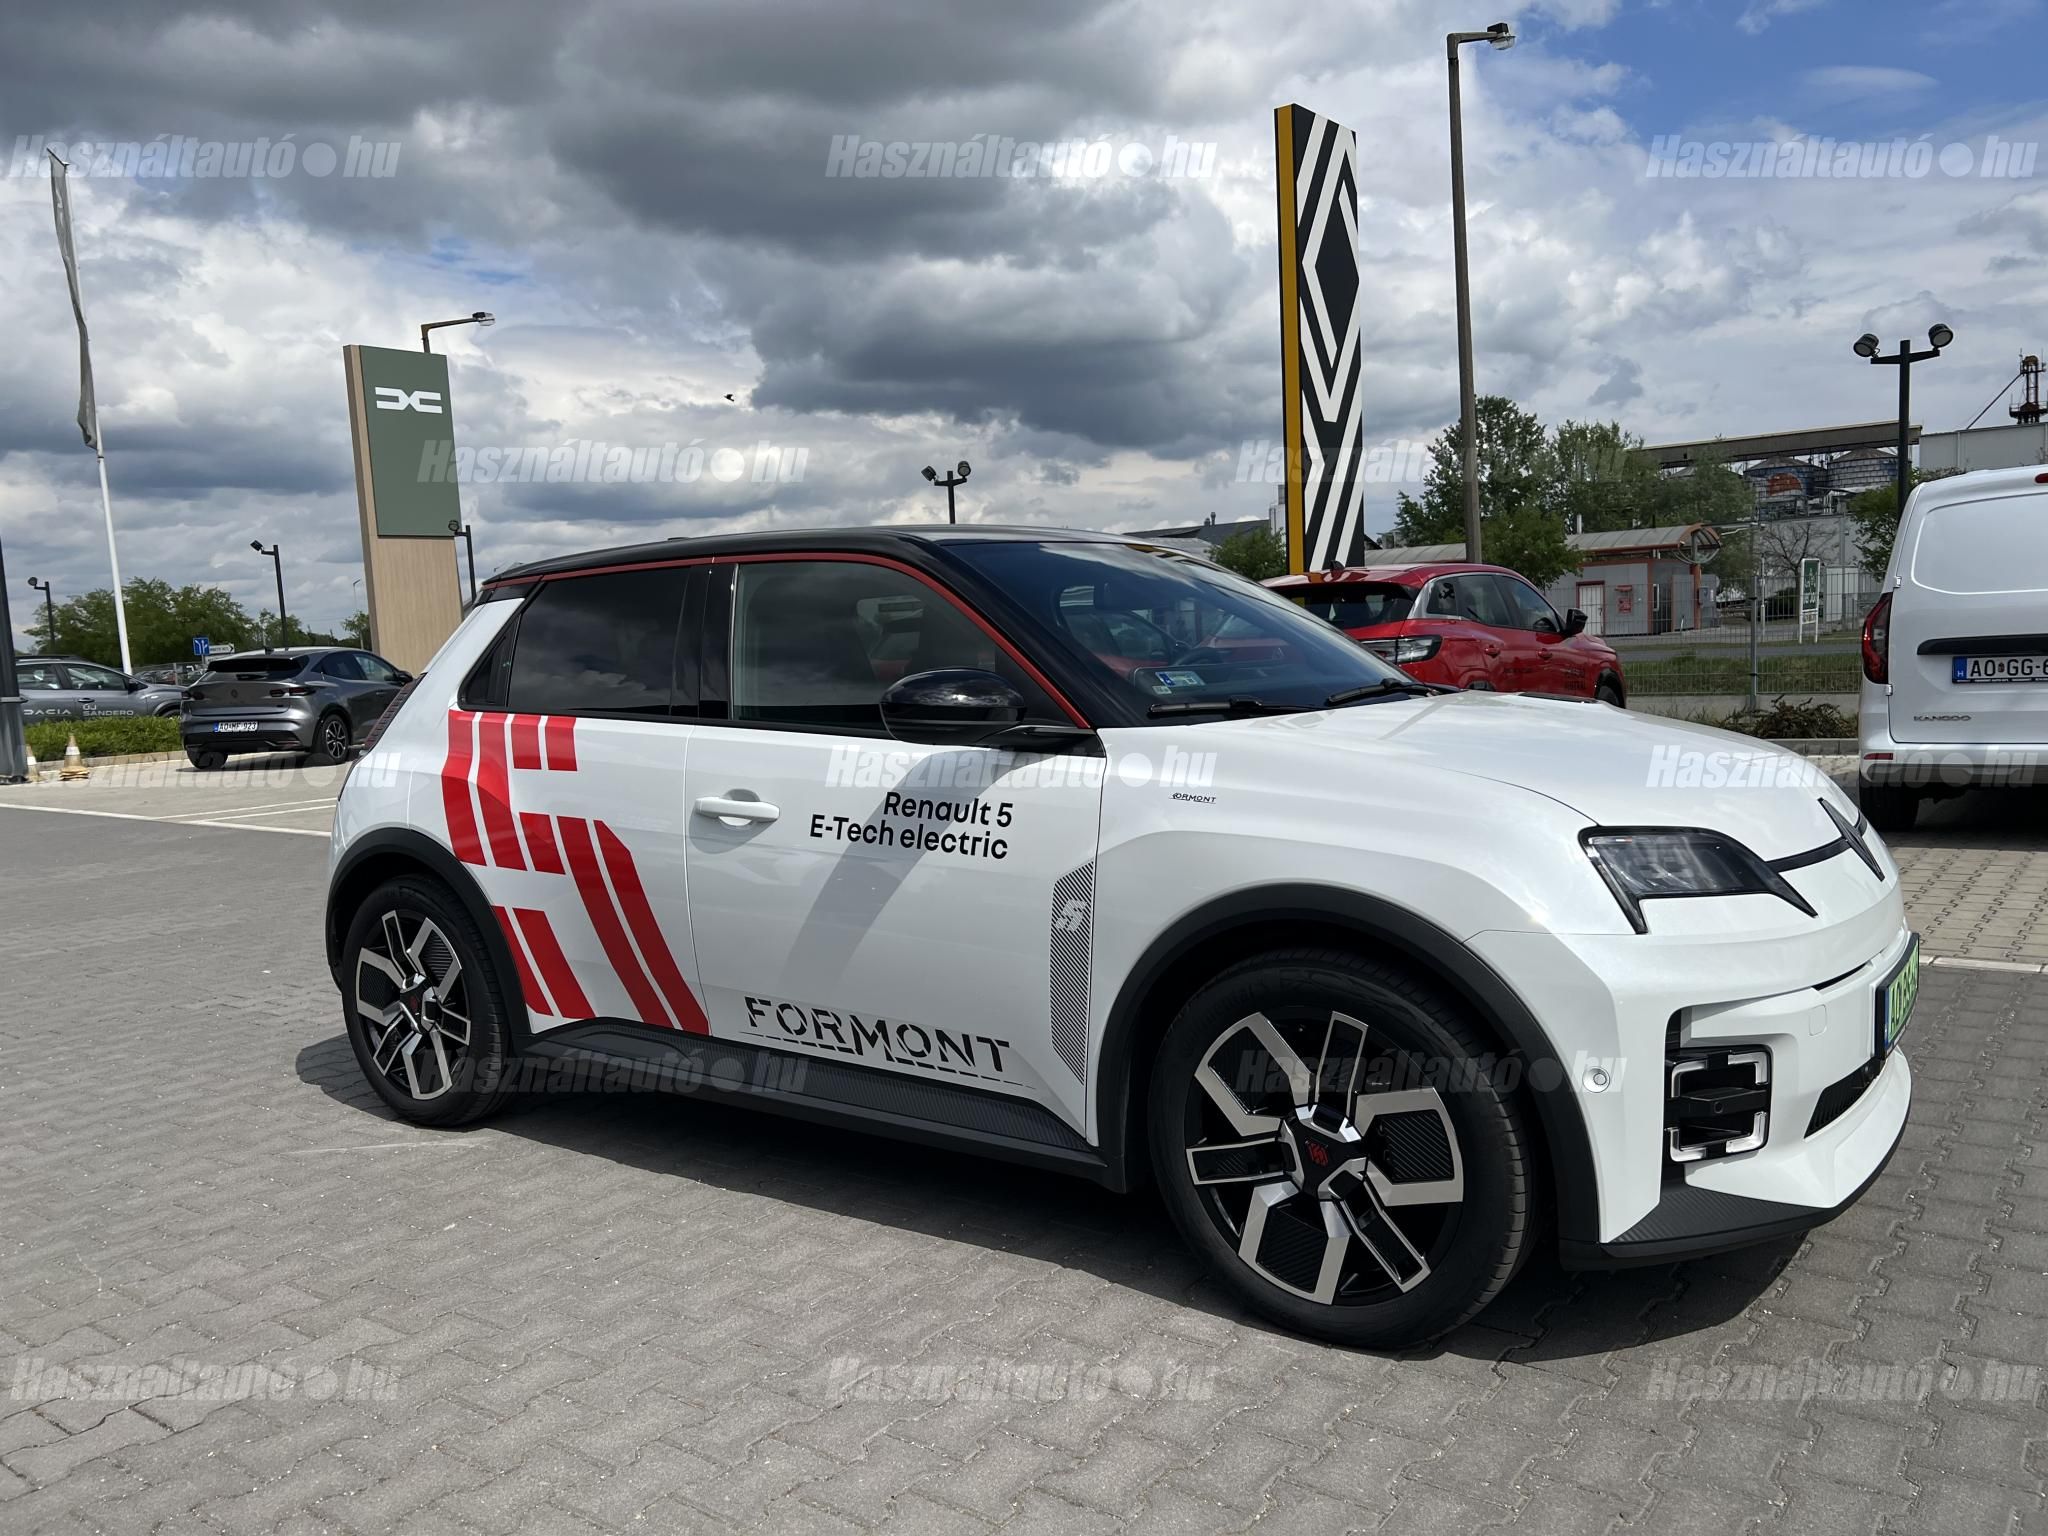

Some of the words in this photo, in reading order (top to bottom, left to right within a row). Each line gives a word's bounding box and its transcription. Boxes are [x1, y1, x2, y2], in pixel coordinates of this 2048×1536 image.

[1970, 659, 1996, 677] AO
[883, 791, 992, 826] Renault
[996, 802, 1014, 828] 5
[809, 813, 894, 847] E-Tech
[900, 823, 1009, 860] electric
[744, 995, 1010, 1073] FORMONT
